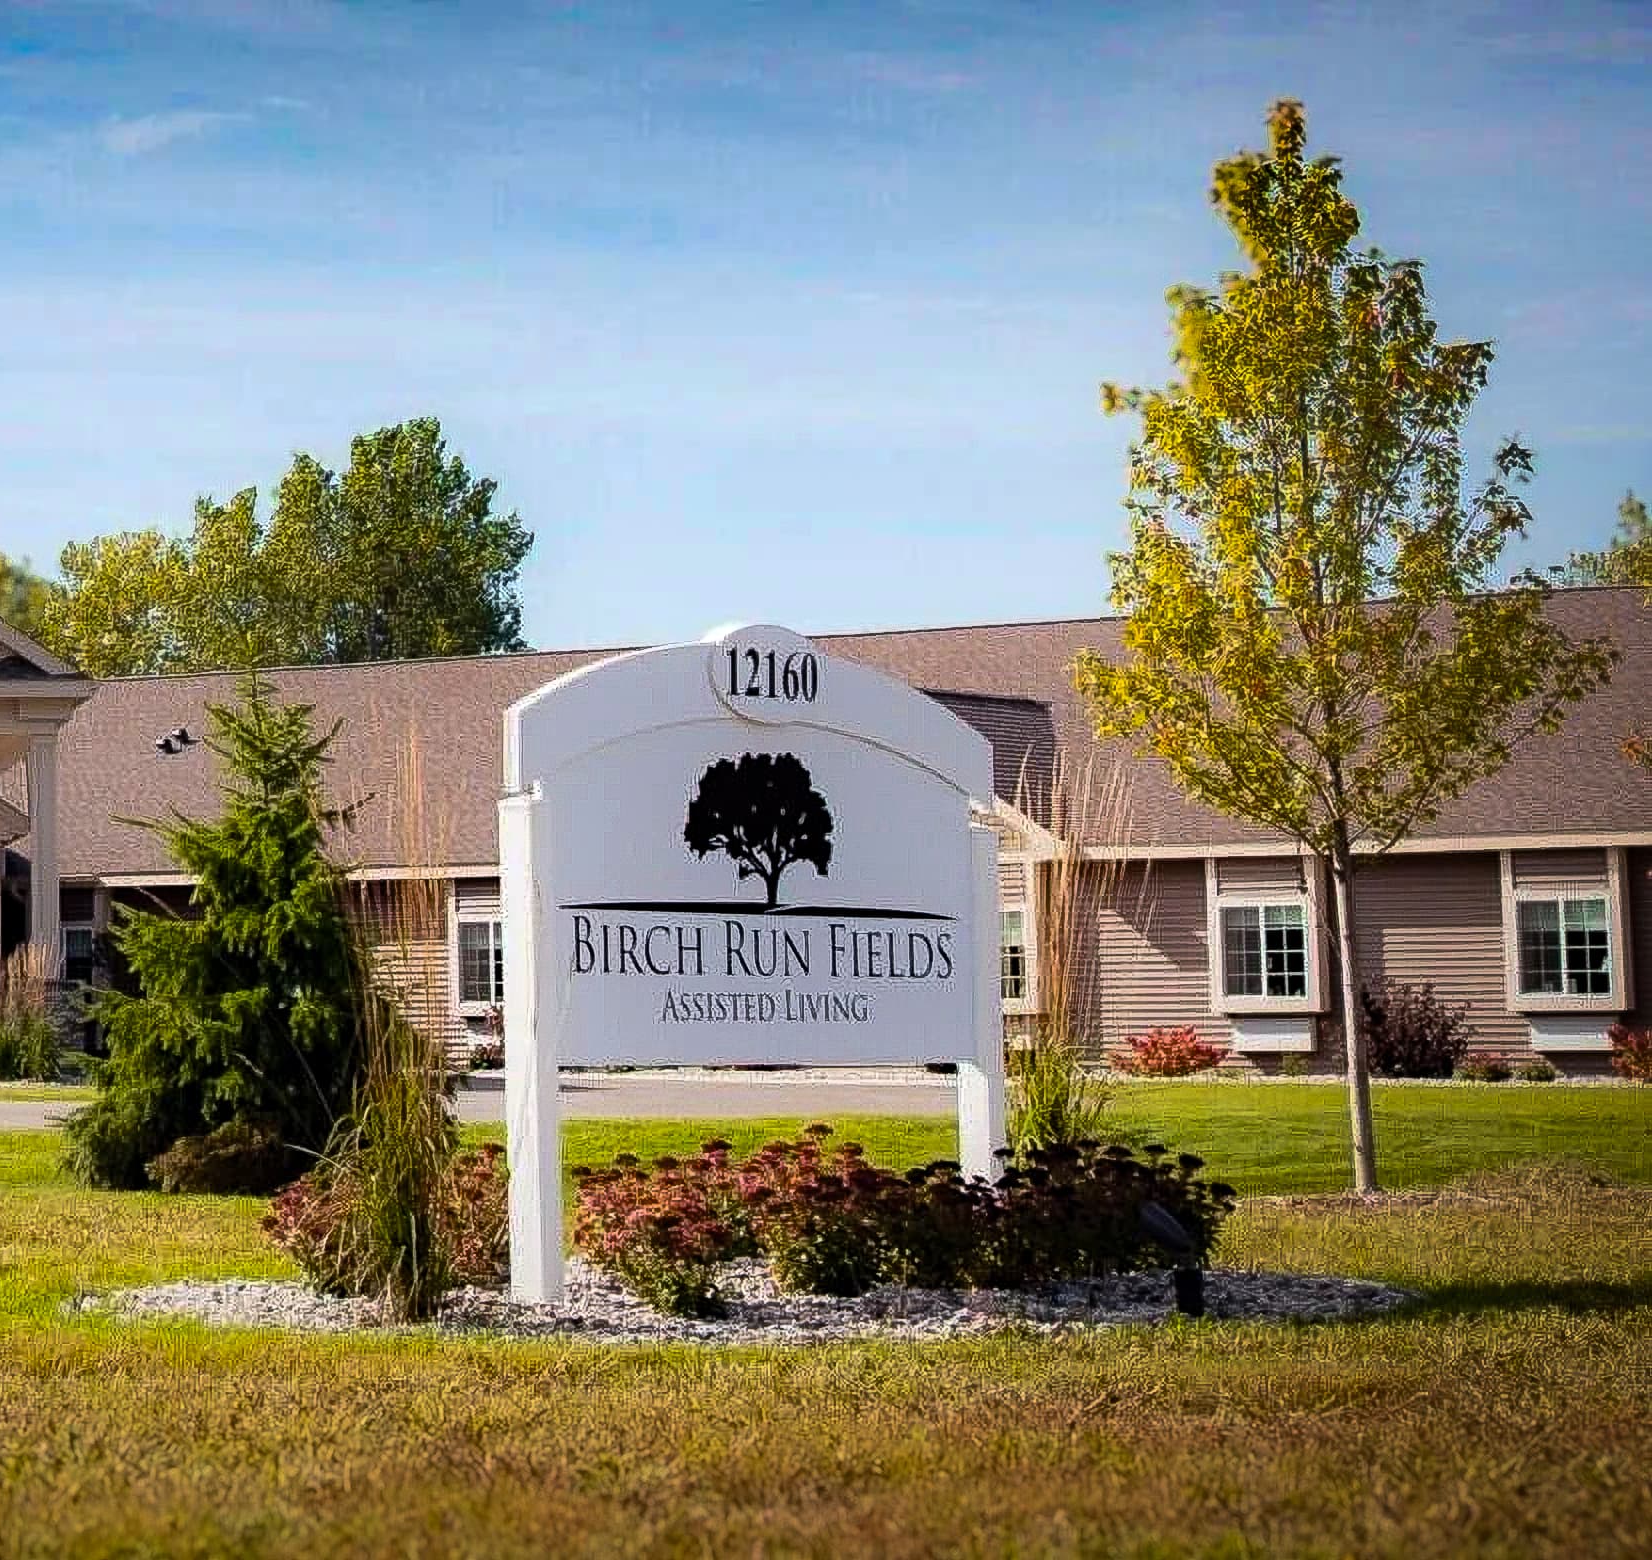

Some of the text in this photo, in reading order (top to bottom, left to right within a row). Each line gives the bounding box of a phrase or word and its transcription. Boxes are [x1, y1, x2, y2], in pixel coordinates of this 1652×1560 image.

[726, 646, 819, 703] 12160
[571, 913, 955, 979] BIRCH RUN FIELDS
[662, 988, 869, 1022] ASSISTED LIVING
